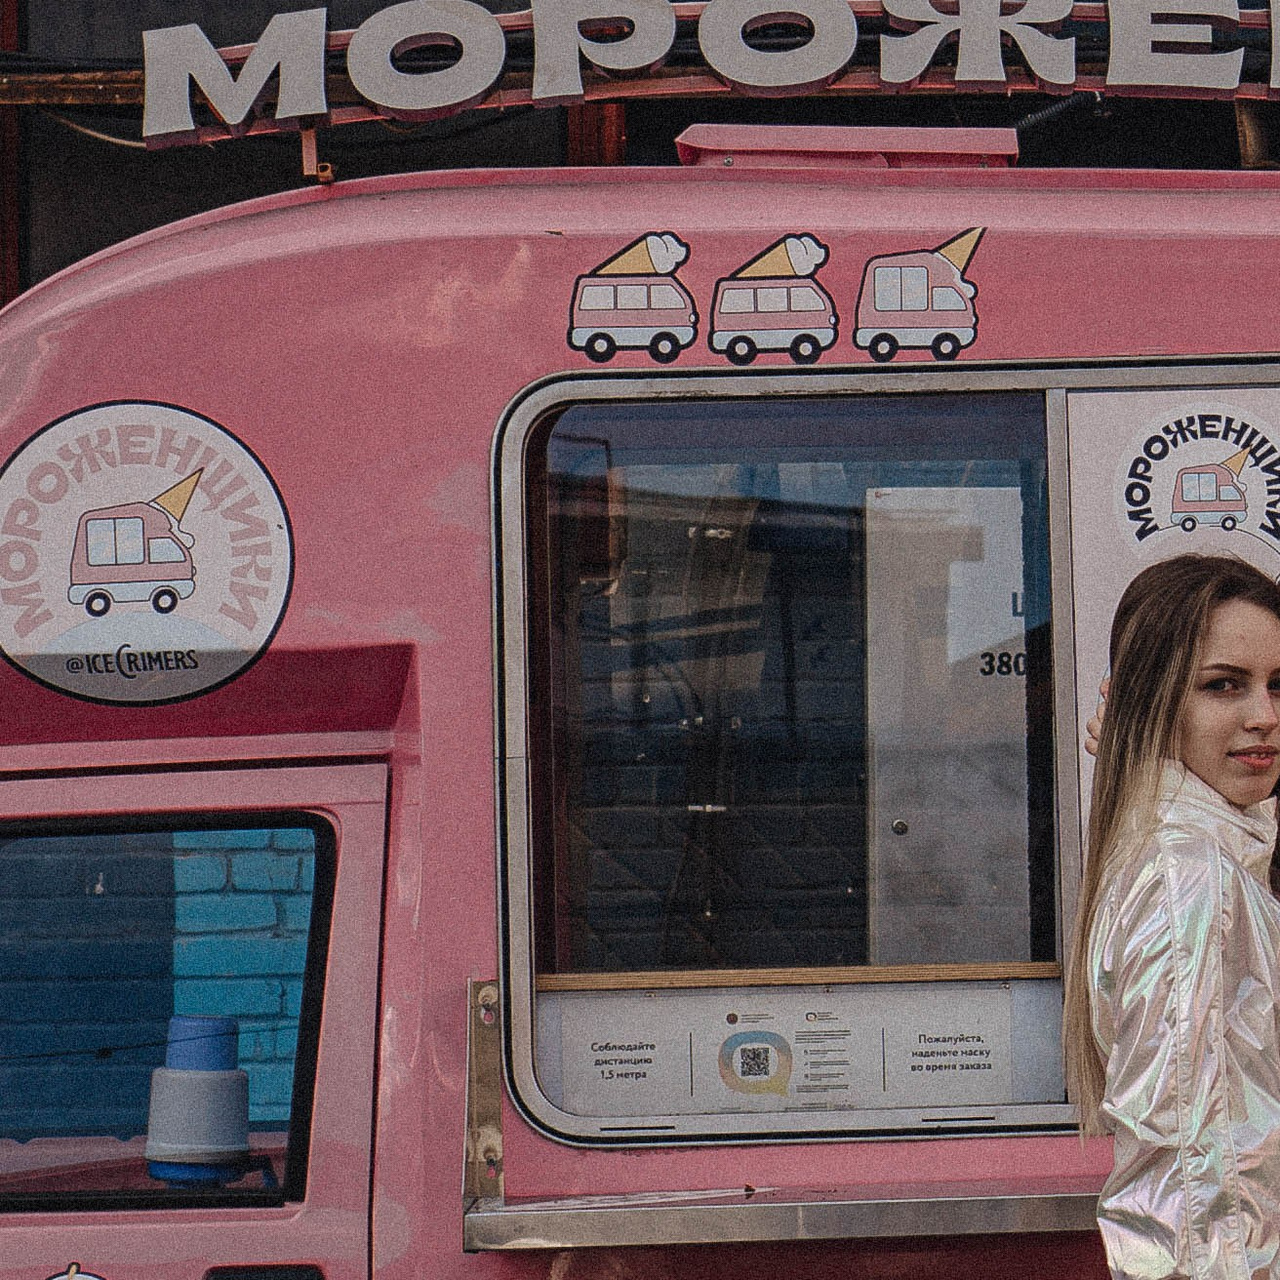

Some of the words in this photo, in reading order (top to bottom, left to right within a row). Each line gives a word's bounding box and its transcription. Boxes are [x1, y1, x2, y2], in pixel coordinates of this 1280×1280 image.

[0, 424, 272, 638] МОРОЖЕНЩИКИ
[918, 1034, 984, 1045] Пожалуйста,
[591, 1042, 656, 1052] Соблюдайте
[912, 1050, 958, 1058] наденьте
[961, 1049, 991, 1058] маску
[594, 1058, 652, 1066] дистанцию
[926, 1064, 957, 1073] время
[617, 1071, 647, 1080] метра
